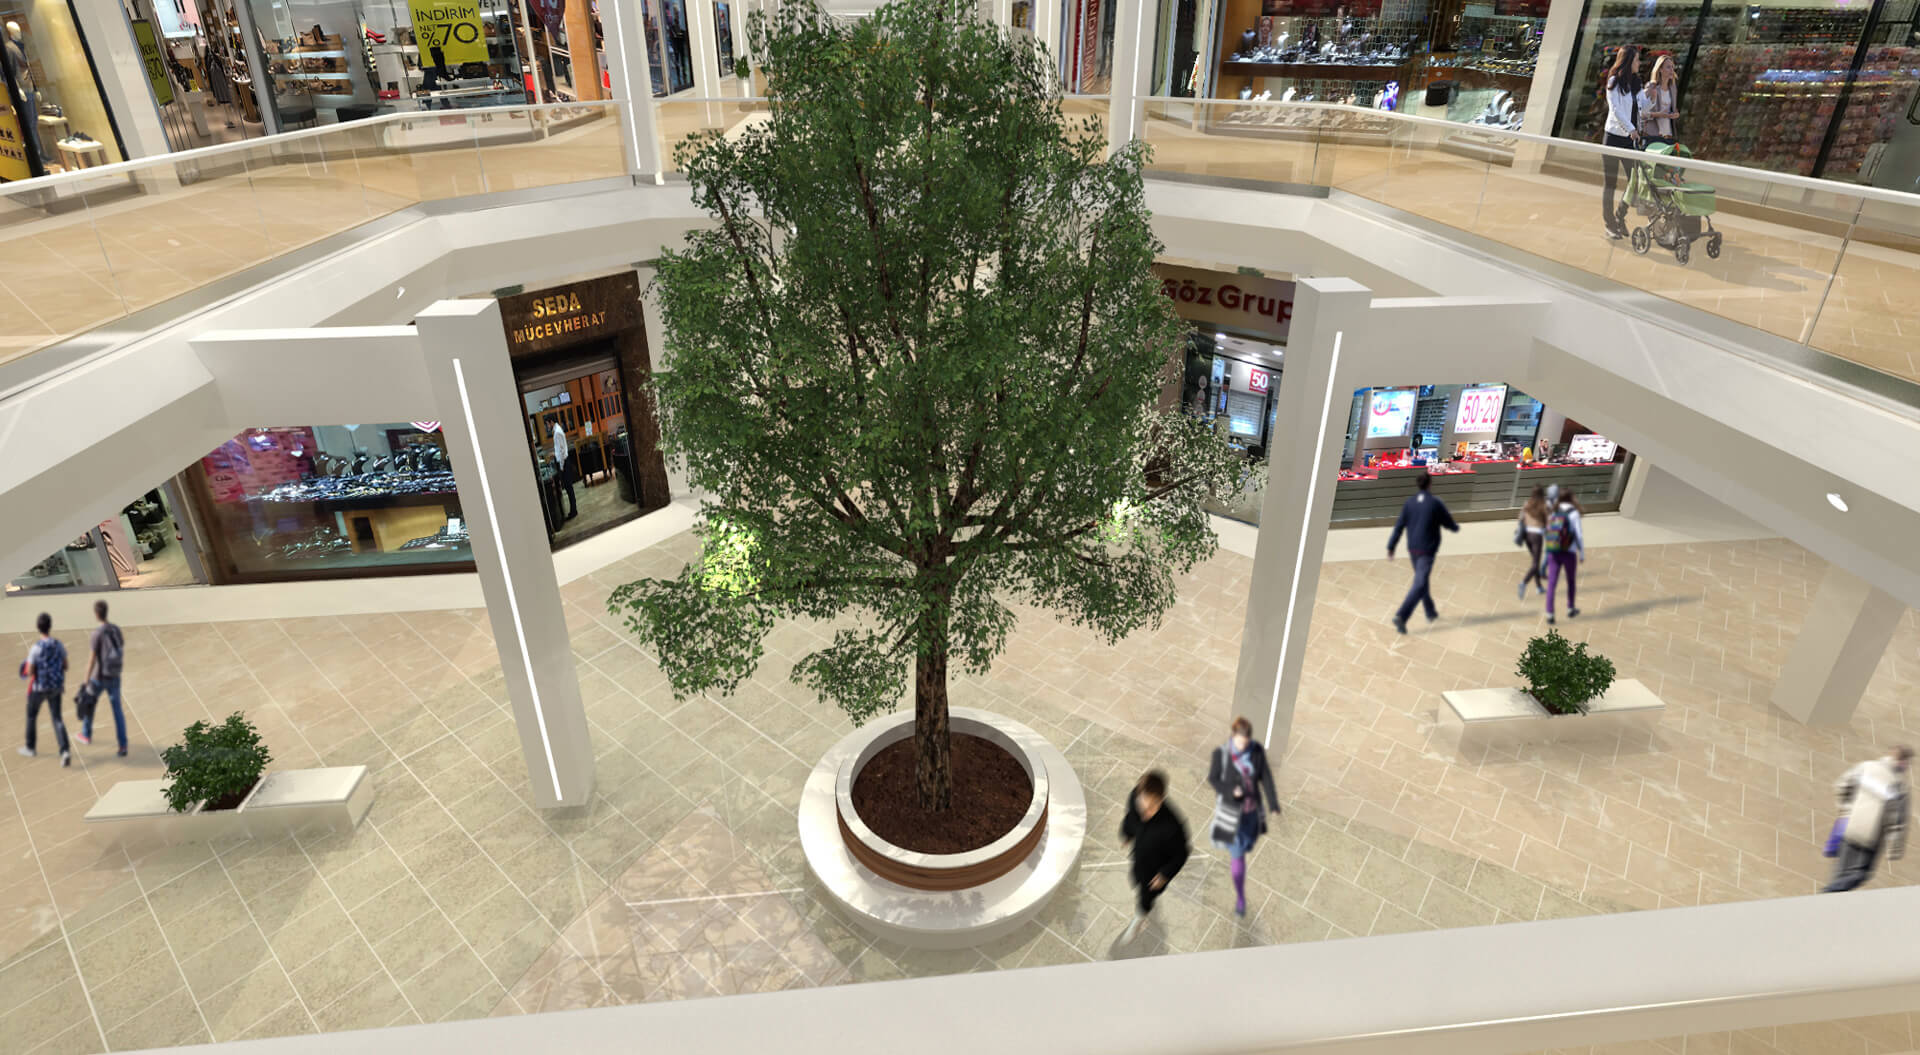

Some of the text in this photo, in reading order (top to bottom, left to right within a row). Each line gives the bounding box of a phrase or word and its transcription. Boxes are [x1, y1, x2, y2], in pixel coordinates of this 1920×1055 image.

[421, 22, 479, 47] %70
[532, 292, 581, 318] SEDA
[1160, 278, 1293, 323] Göz Grup
[513, 311, 606, 344] MÜCEVHERAT
[1251, 371, 1268, 389] 50
